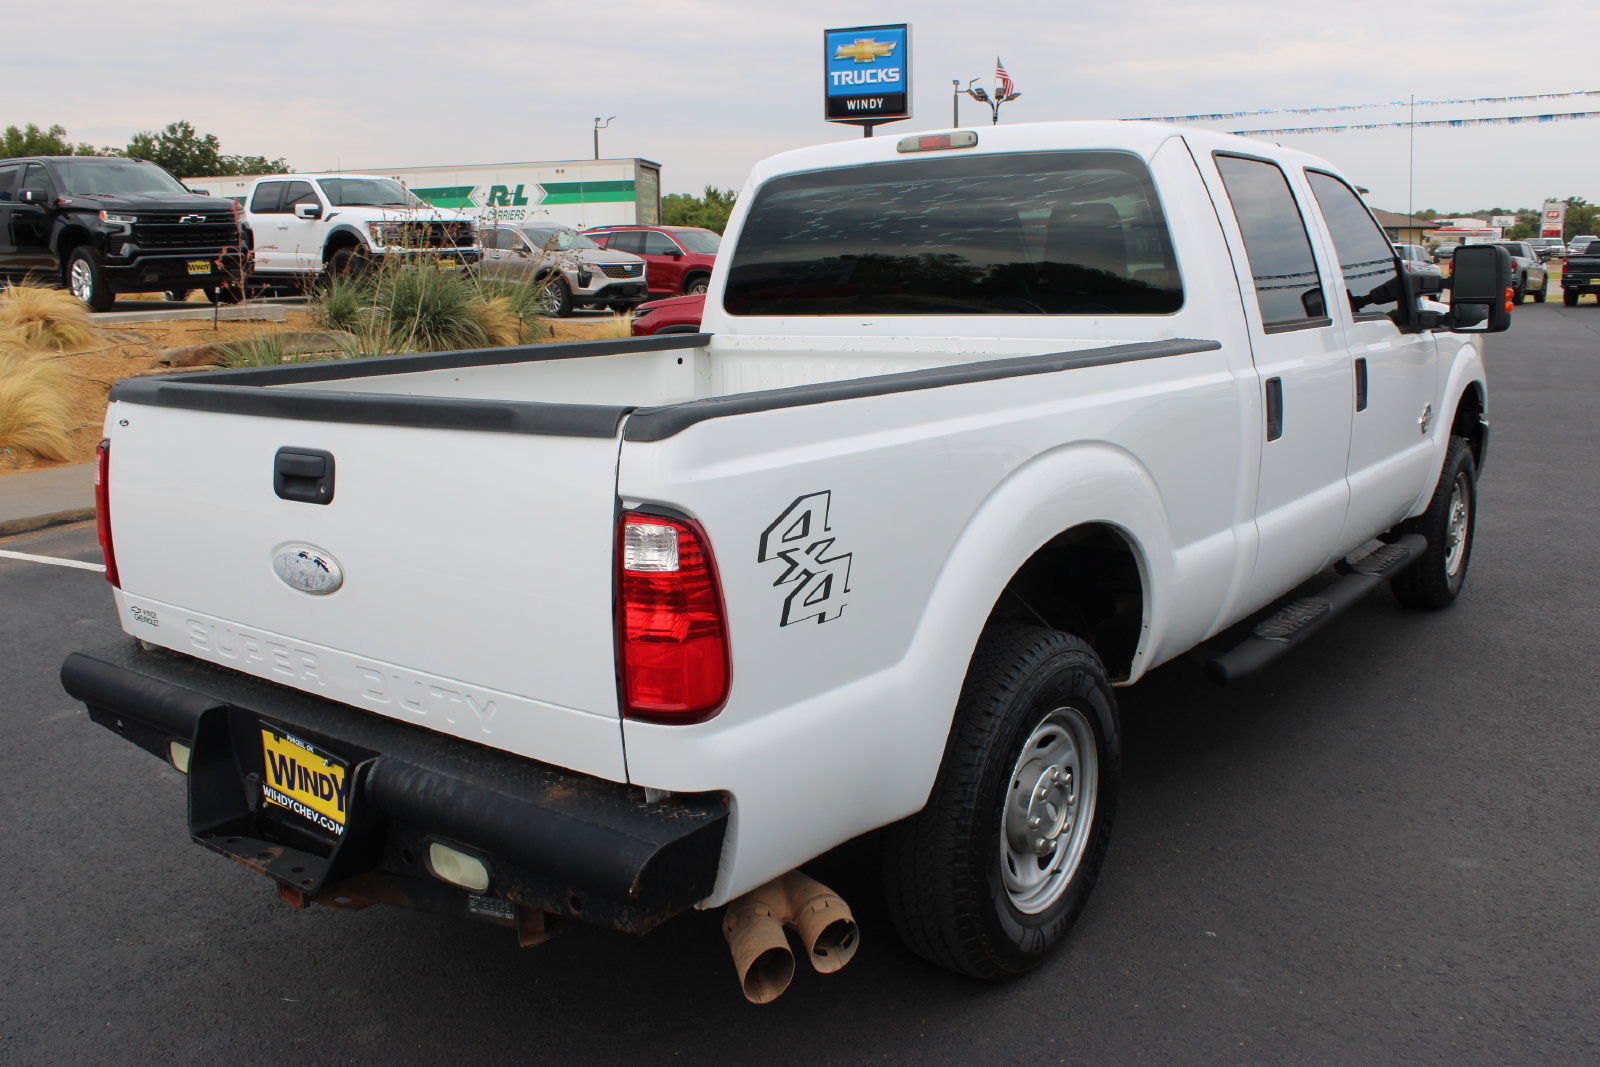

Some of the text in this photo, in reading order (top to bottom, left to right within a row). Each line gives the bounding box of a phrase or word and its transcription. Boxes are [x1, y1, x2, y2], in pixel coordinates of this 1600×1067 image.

[830, 67, 900, 86] TRUCKS
[846, 98, 884, 110] WINDY
[188, 263, 210, 271] WINDY
[186, 618, 498, 734] SUPER DUTY
[266, 748, 346, 813] WINDY
[262, 784, 345, 836] WINDYCHEV.COM
